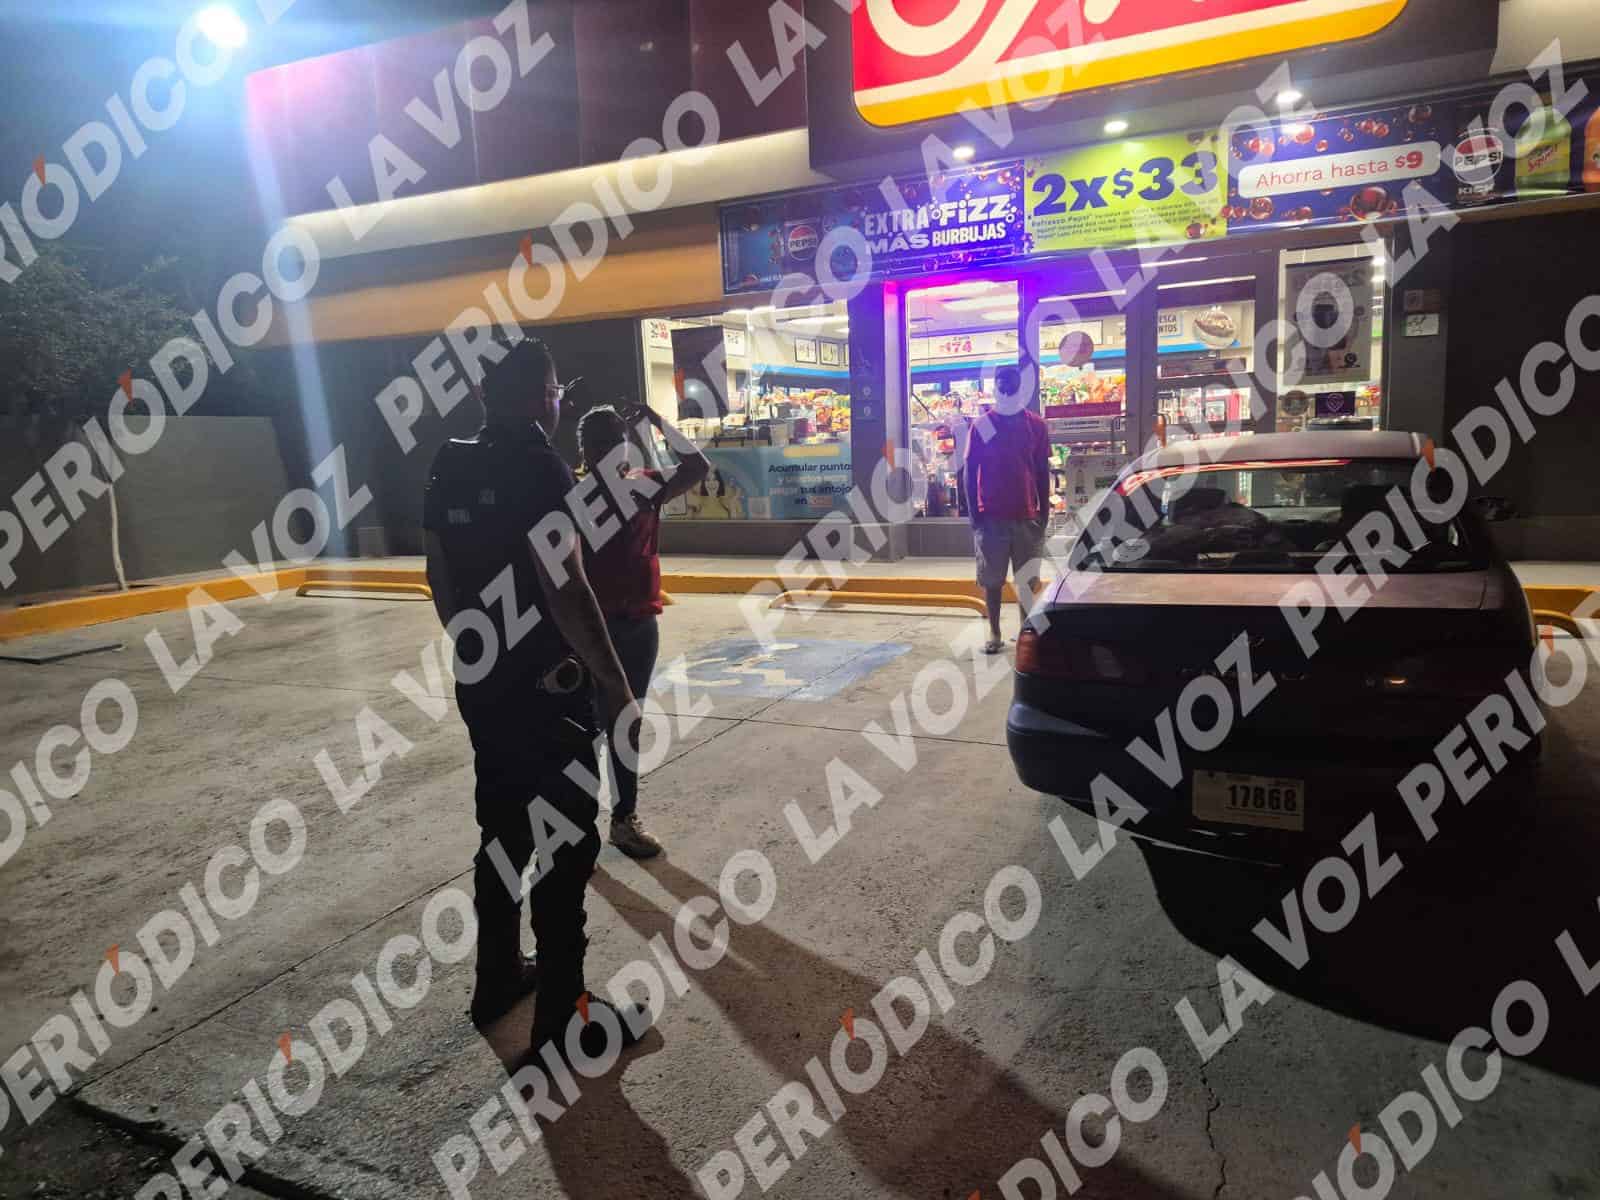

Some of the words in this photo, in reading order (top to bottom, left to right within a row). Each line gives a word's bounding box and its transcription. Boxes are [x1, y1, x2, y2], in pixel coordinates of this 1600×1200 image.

[1256, 169, 1324, 189] Ahorra
[1331, 160, 1389, 178] hasta
[1394, 151, 1423, 170] $9
[1454, 151, 1504, 167] PEPSI
[864, 206, 930, 236] EXTRA
[865, 232, 930, 255] MÁS
[932, 222, 1007, 248] BURBUJAS
